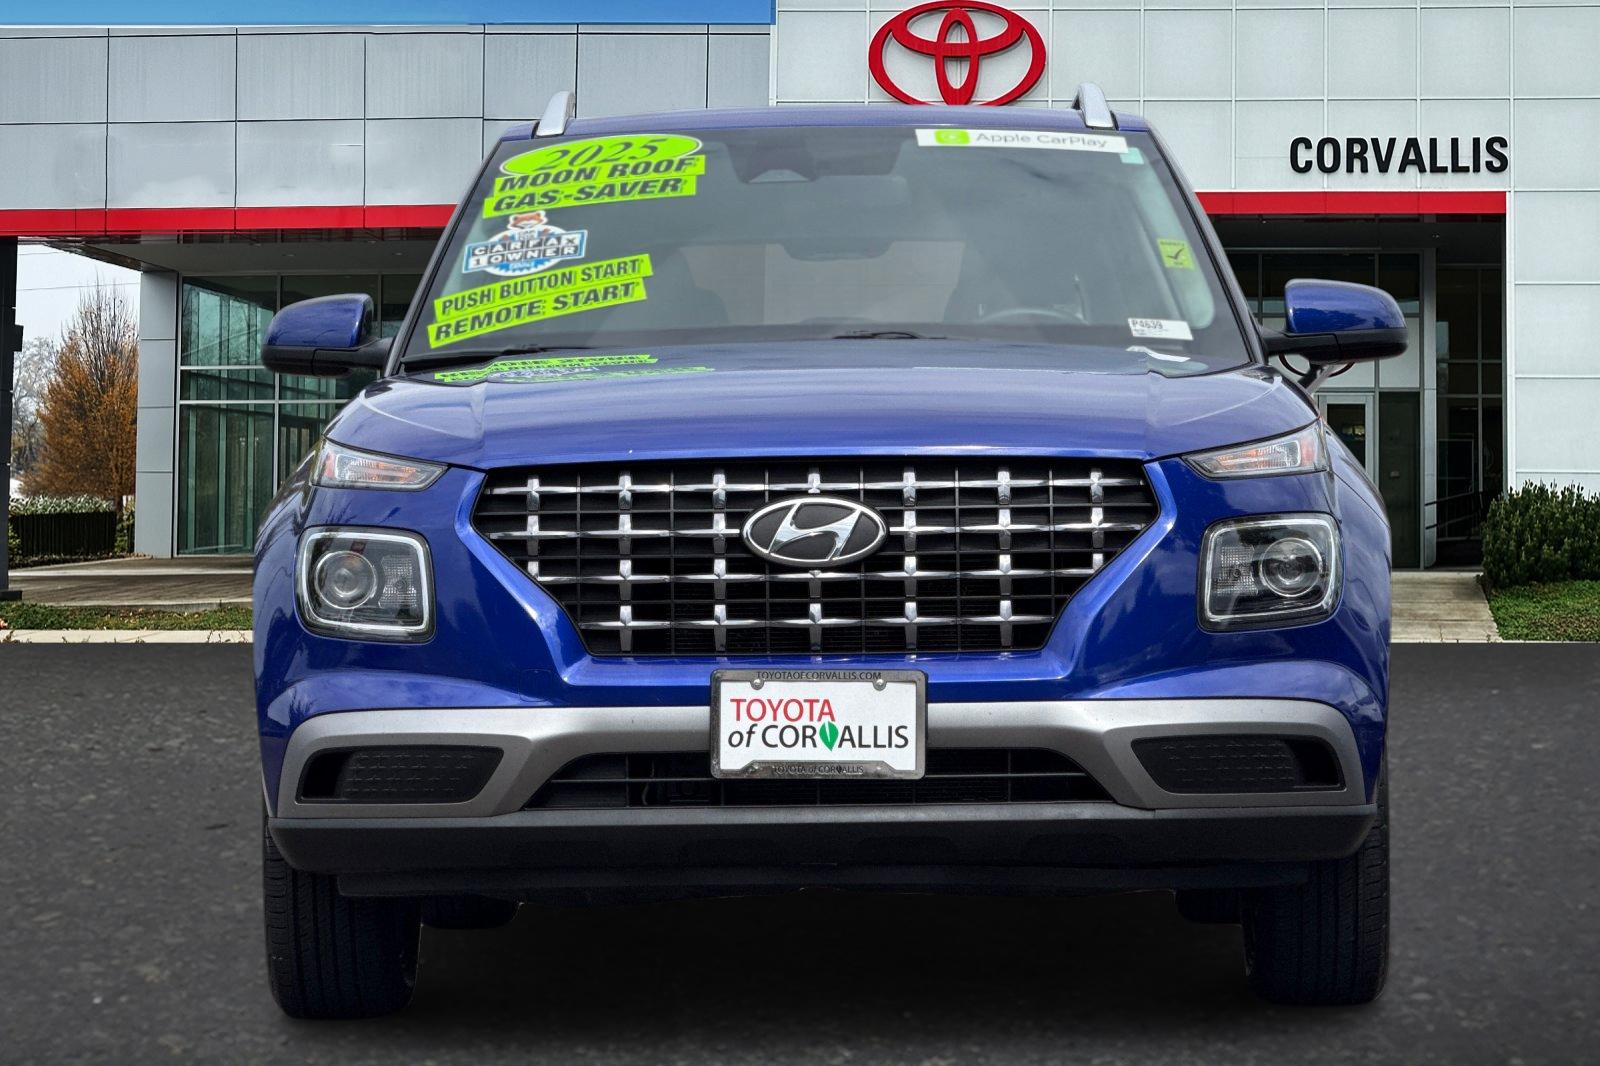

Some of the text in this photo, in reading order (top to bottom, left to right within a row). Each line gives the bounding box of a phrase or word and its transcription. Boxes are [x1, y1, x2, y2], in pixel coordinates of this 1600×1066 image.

[533, 138, 668, 171] 2025
[976, 132, 1108, 148] Apple CarPlay
[1290, 136, 1509, 173] CORVALLIS
[499, 156, 698, 193] MOON ROOF
[473, 236, 578, 256] CARFAX
[441, 259, 643, 317] PUSH BUTTON START
[434, 281, 637, 341] REMOTE START
[756, 671, 882, 681] TOYOTAOFCORVALLIS.COM
[730, 698, 835, 722] TOYOTA
[728, 723, 756, 748] of
